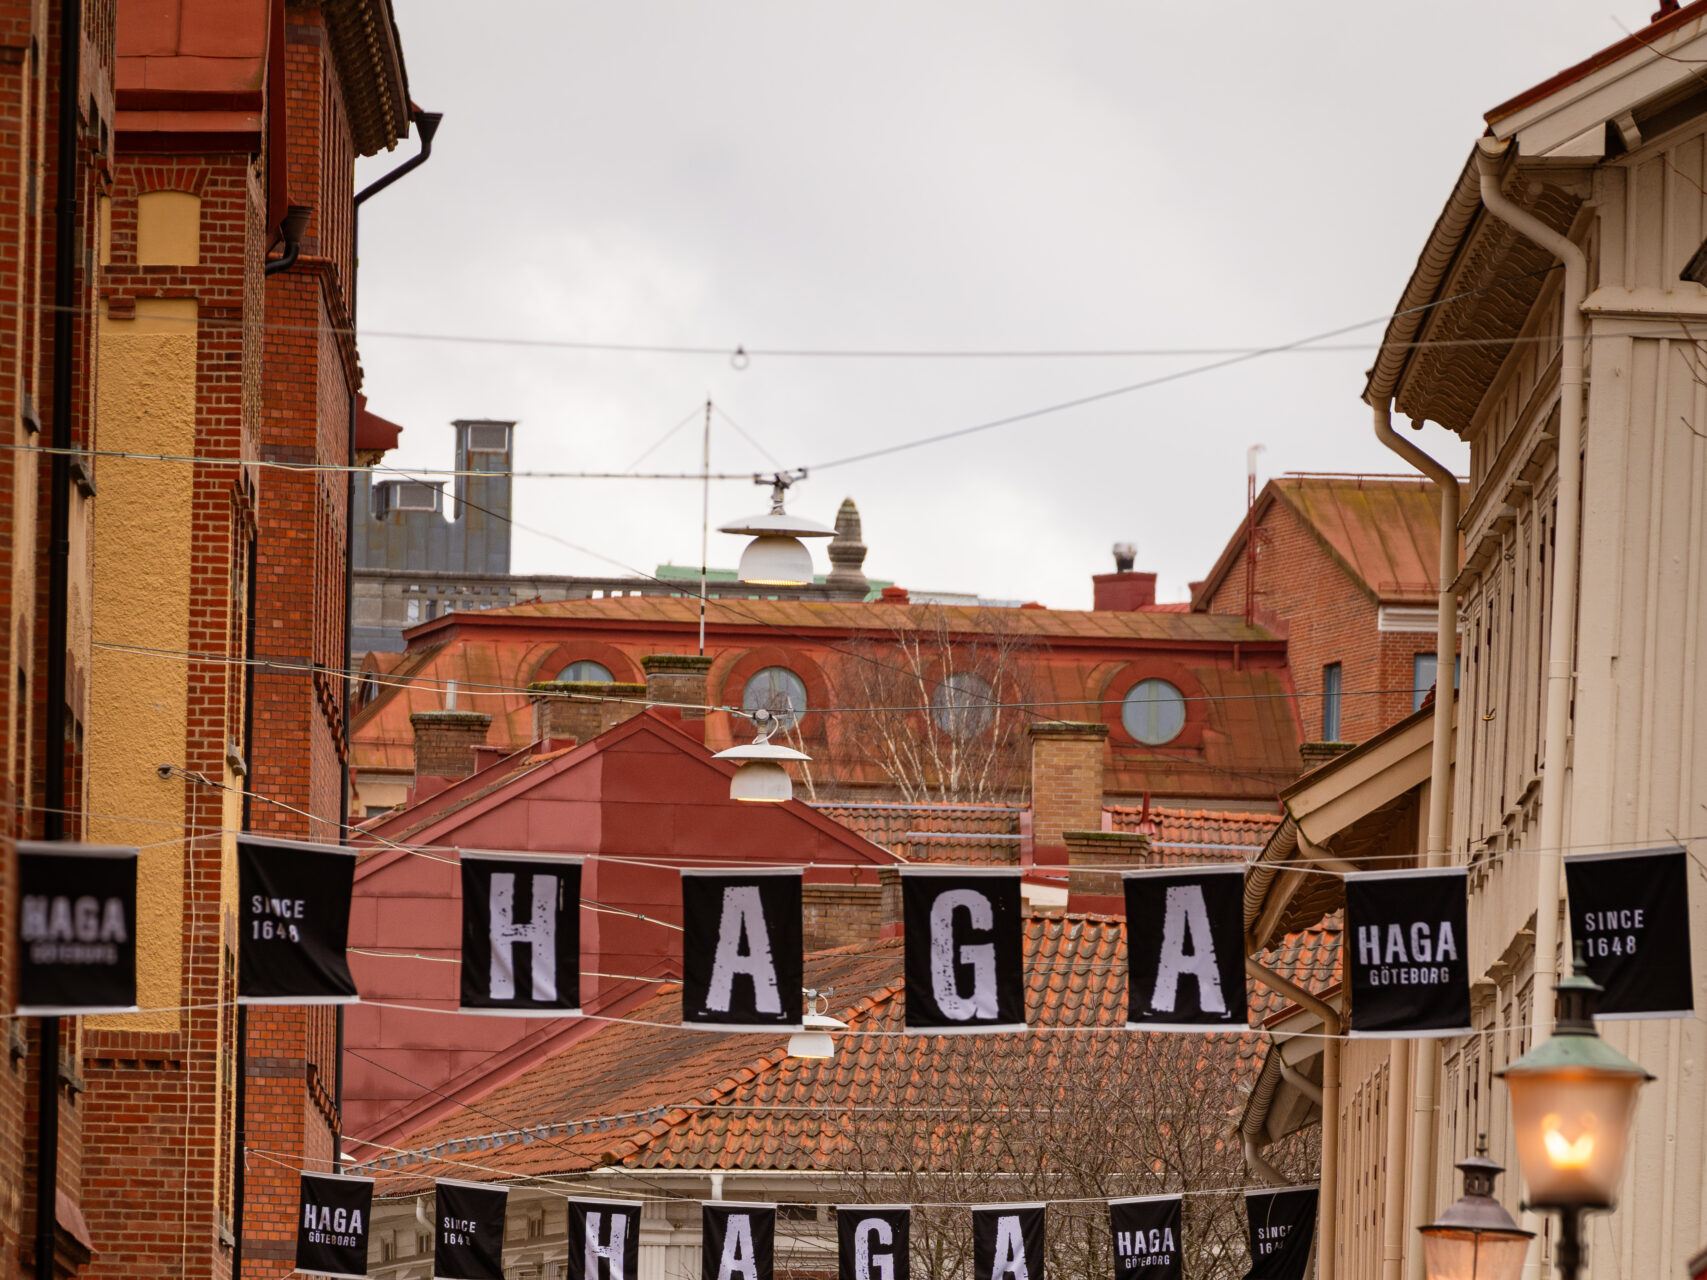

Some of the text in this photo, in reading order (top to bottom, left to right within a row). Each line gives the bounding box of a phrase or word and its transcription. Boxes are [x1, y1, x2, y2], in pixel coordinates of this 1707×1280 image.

[22, 894, 128, 942] HAGA
[252, 895, 305, 919] SINCE
[1584, 909, 1645, 931] SINCE
[489, 872, 559, 1000] H
[704, 885, 783, 1013] A
[1150, 884, 1228, 1014] A
[1358, 921, 1458, 965] HAGA
[1586, 935, 1637, 957] 1648
[929, 888, 1000, 1020] G
[1369, 966, 1450, 986] GÖTEBORG
[304, 1203, 363, 1235] HAGA
[444, 1216, 476, 1233] SINCE
[308, 1230, 356, 1247] GÖTEBORG
[1117, 1228, 1175, 1256] HAGA
[1259, 1240, 1284, 1255] 16
